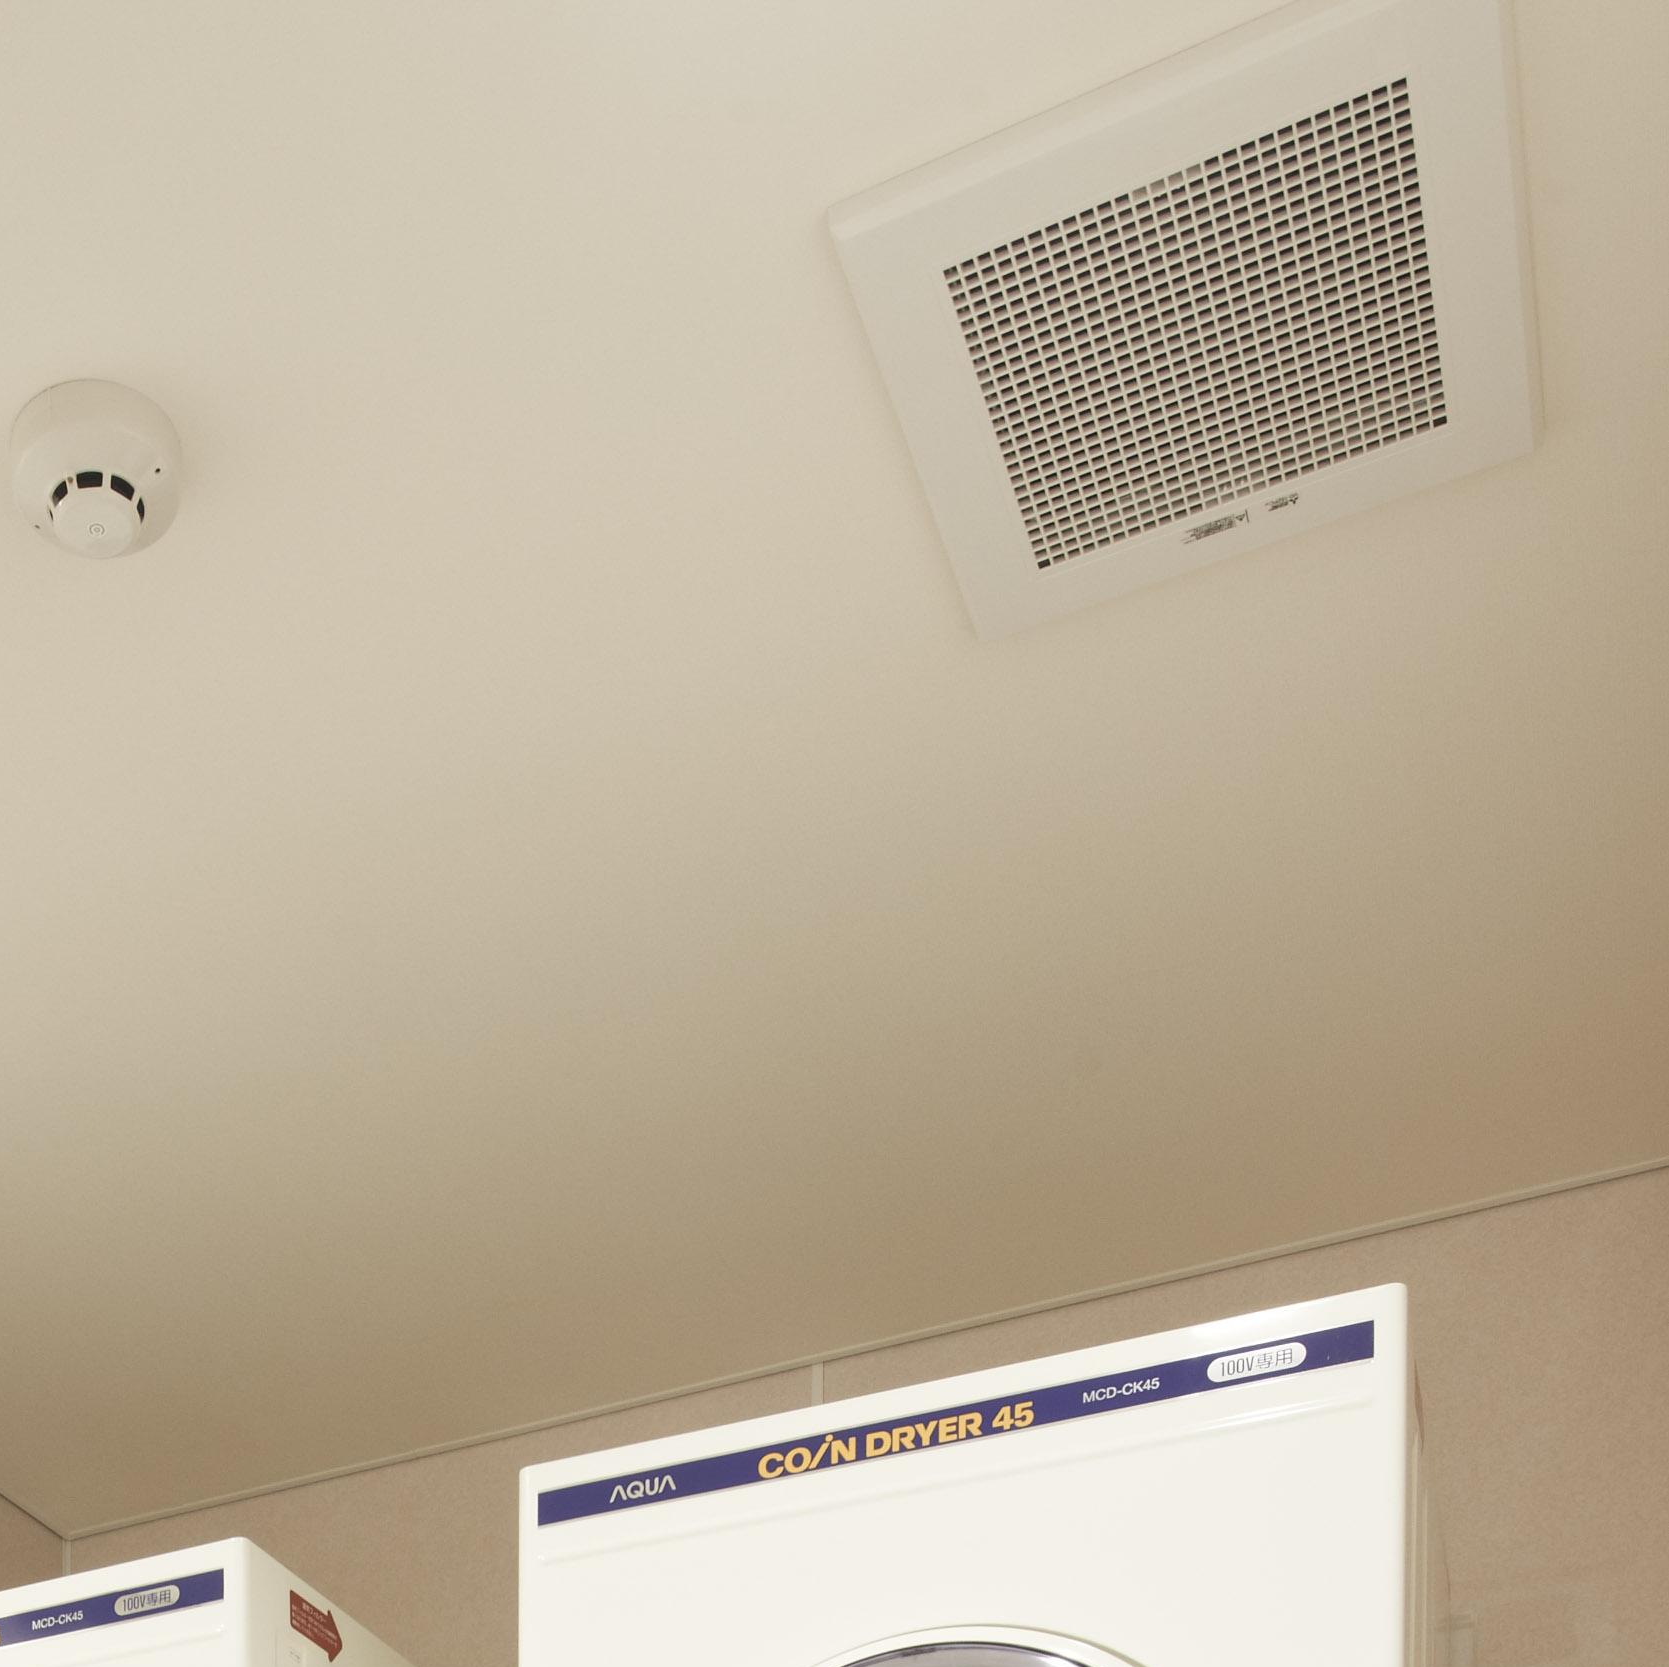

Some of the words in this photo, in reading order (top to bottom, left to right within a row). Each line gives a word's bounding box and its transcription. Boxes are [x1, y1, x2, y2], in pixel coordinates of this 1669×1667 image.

[1218, 1347, 1295, 1378] 100V専用
[1082, 1377, 1161, 1404] MCD-CK45
[865, 1413, 983, 1462] DRYER
[992, 1402, 1034, 1432] 45
[609, 1473, 676, 1504] AQUA
[121, 1590, 171, 1613] 100V専用
[32, 1610, 83, 1631] MCD-CK45
